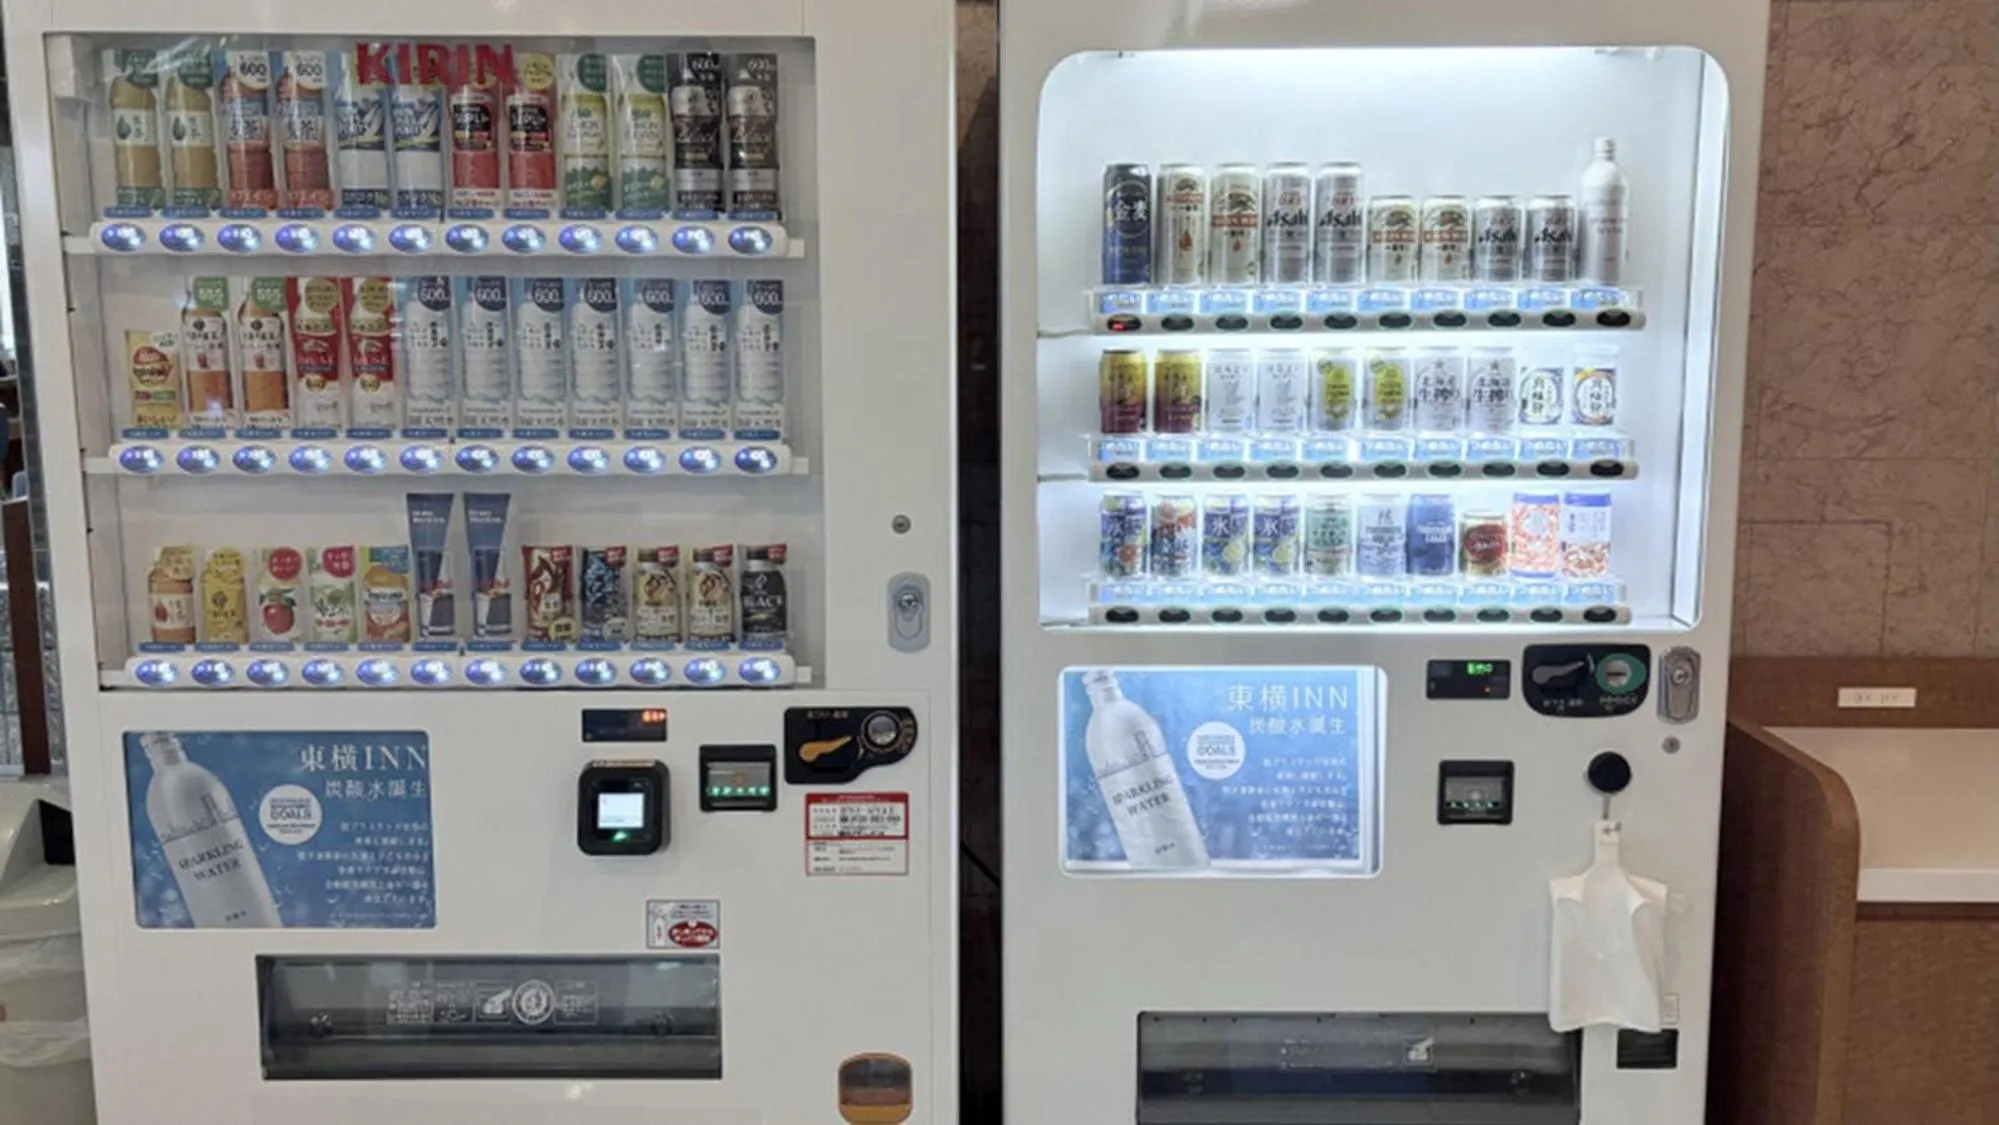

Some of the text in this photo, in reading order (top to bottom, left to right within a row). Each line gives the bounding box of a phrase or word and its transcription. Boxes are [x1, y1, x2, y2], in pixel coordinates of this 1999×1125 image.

[356, 43, 515, 85] KIRIN
[1267, 208, 1308, 227] Asahi
[1319, 208, 1362, 227] Asahi
[1478, 227, 1518, 244] Asahi
[1534, 227, 1573, 244] Asahi
[1226, 684, 1348, 712] 東横INN
[300, 743, 428, 773] 東横INN
[1112, 776, 1173, 805] SPARKLING
[1127, 792, 1170, 818] WATER
[178, 839, 244, 870] SPARKLING
[194, 857, 242, 882] WATER
